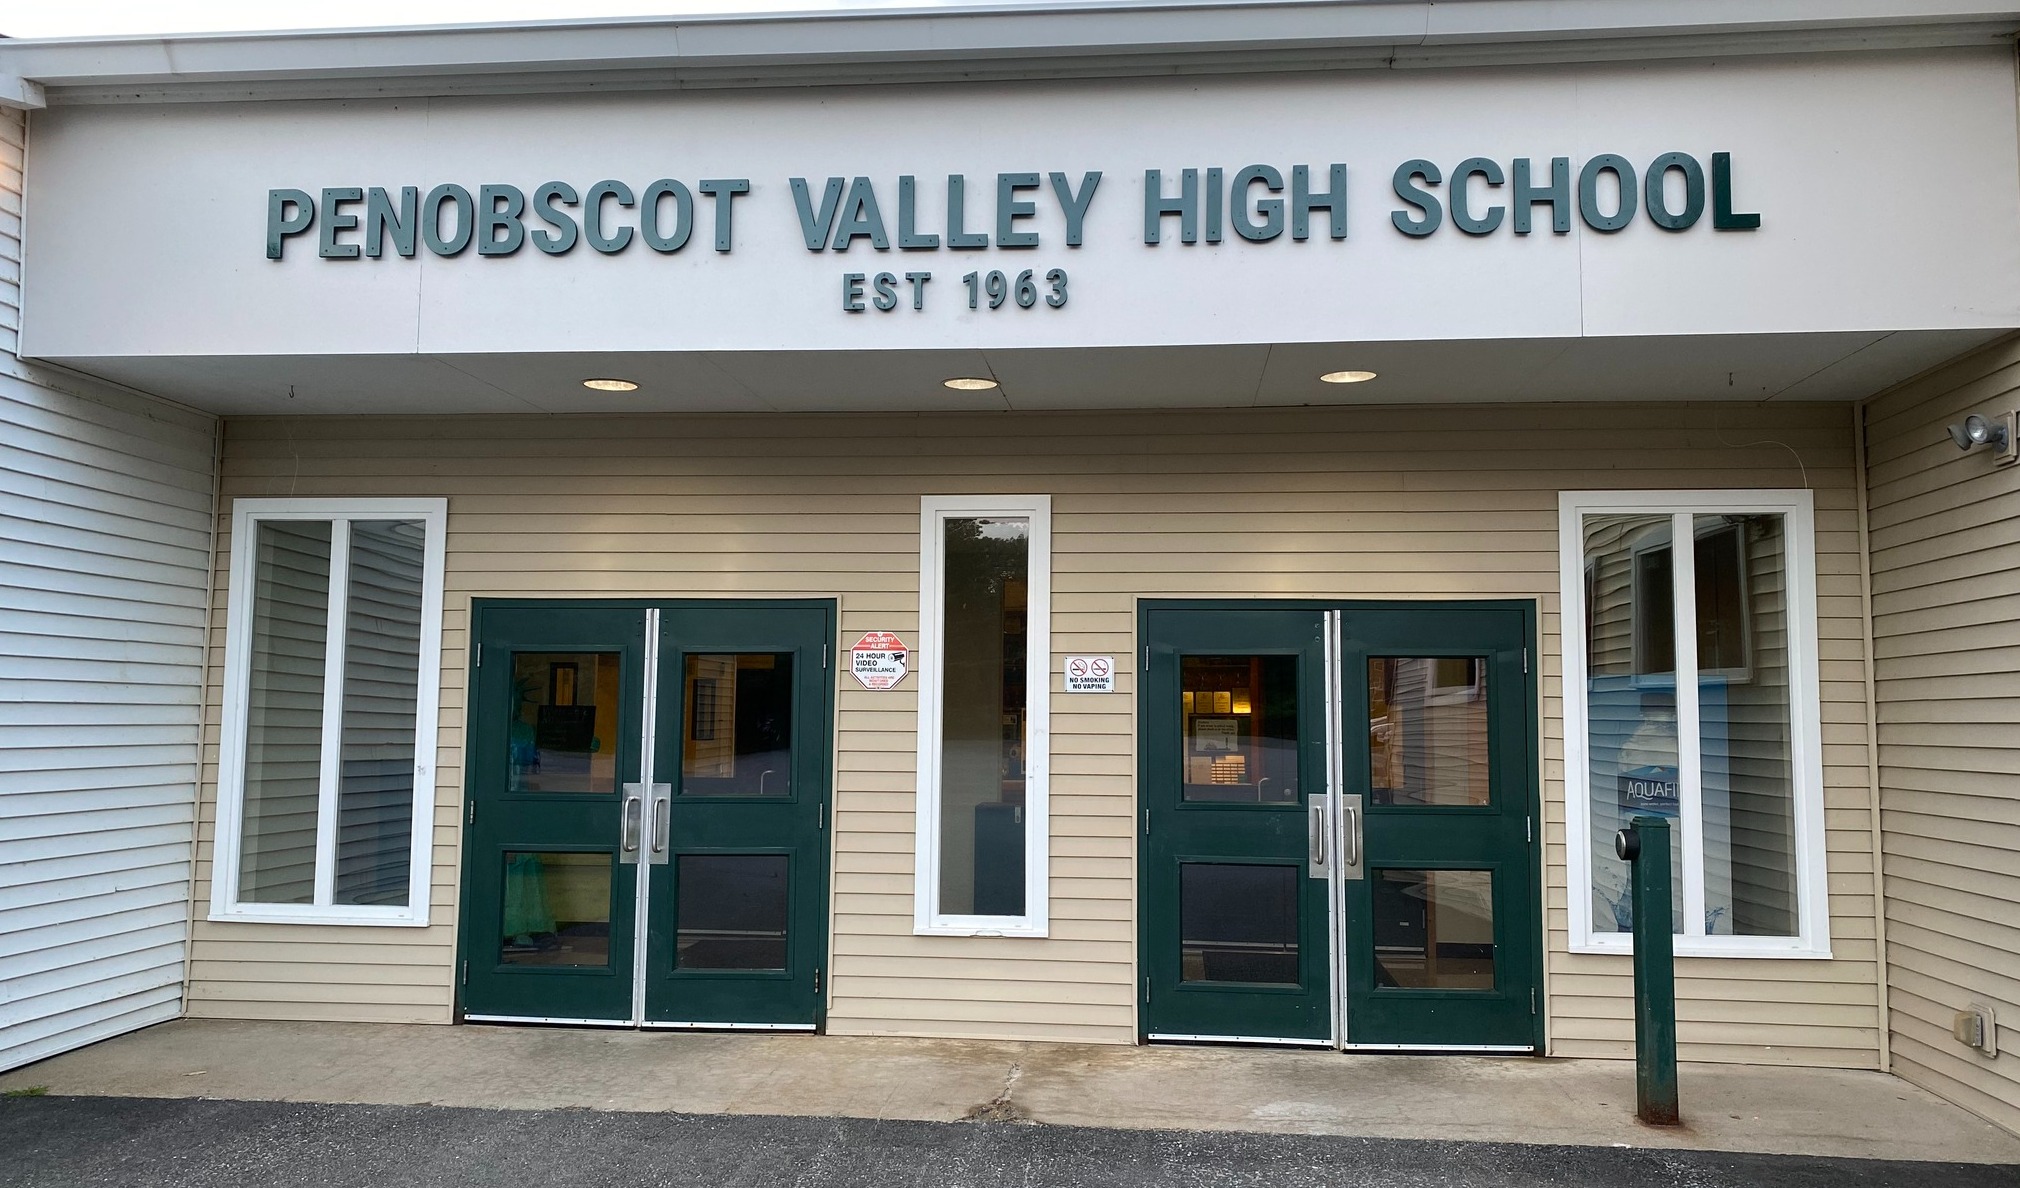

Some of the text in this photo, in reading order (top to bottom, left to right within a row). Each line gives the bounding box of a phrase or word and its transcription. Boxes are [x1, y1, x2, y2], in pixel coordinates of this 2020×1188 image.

[266, 151, 1761, 259] PENOBSCOT VALLEY HIGH SCHOOL
[843, 268, 1069, 312] EST 1963
